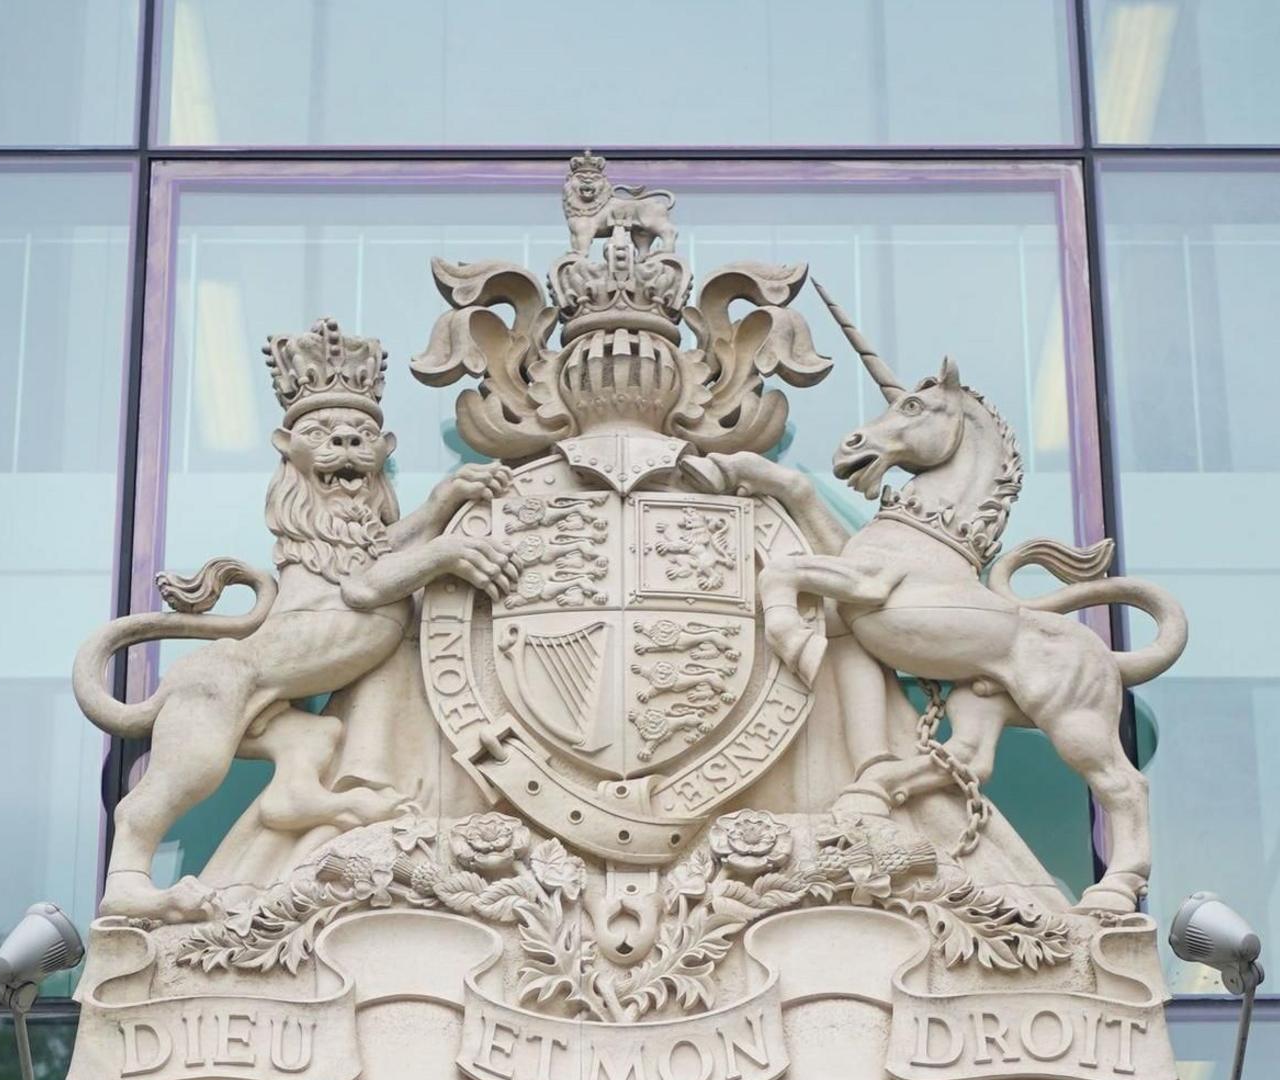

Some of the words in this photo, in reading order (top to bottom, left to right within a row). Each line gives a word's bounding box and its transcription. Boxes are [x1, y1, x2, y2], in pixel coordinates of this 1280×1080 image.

[428, 612, 489, 734] HONI
[677, 691, 801, 812] PENSE
[118, 1011, 317, 1078] DIEU
[910, 1009, 1149, 1075] DROIT
